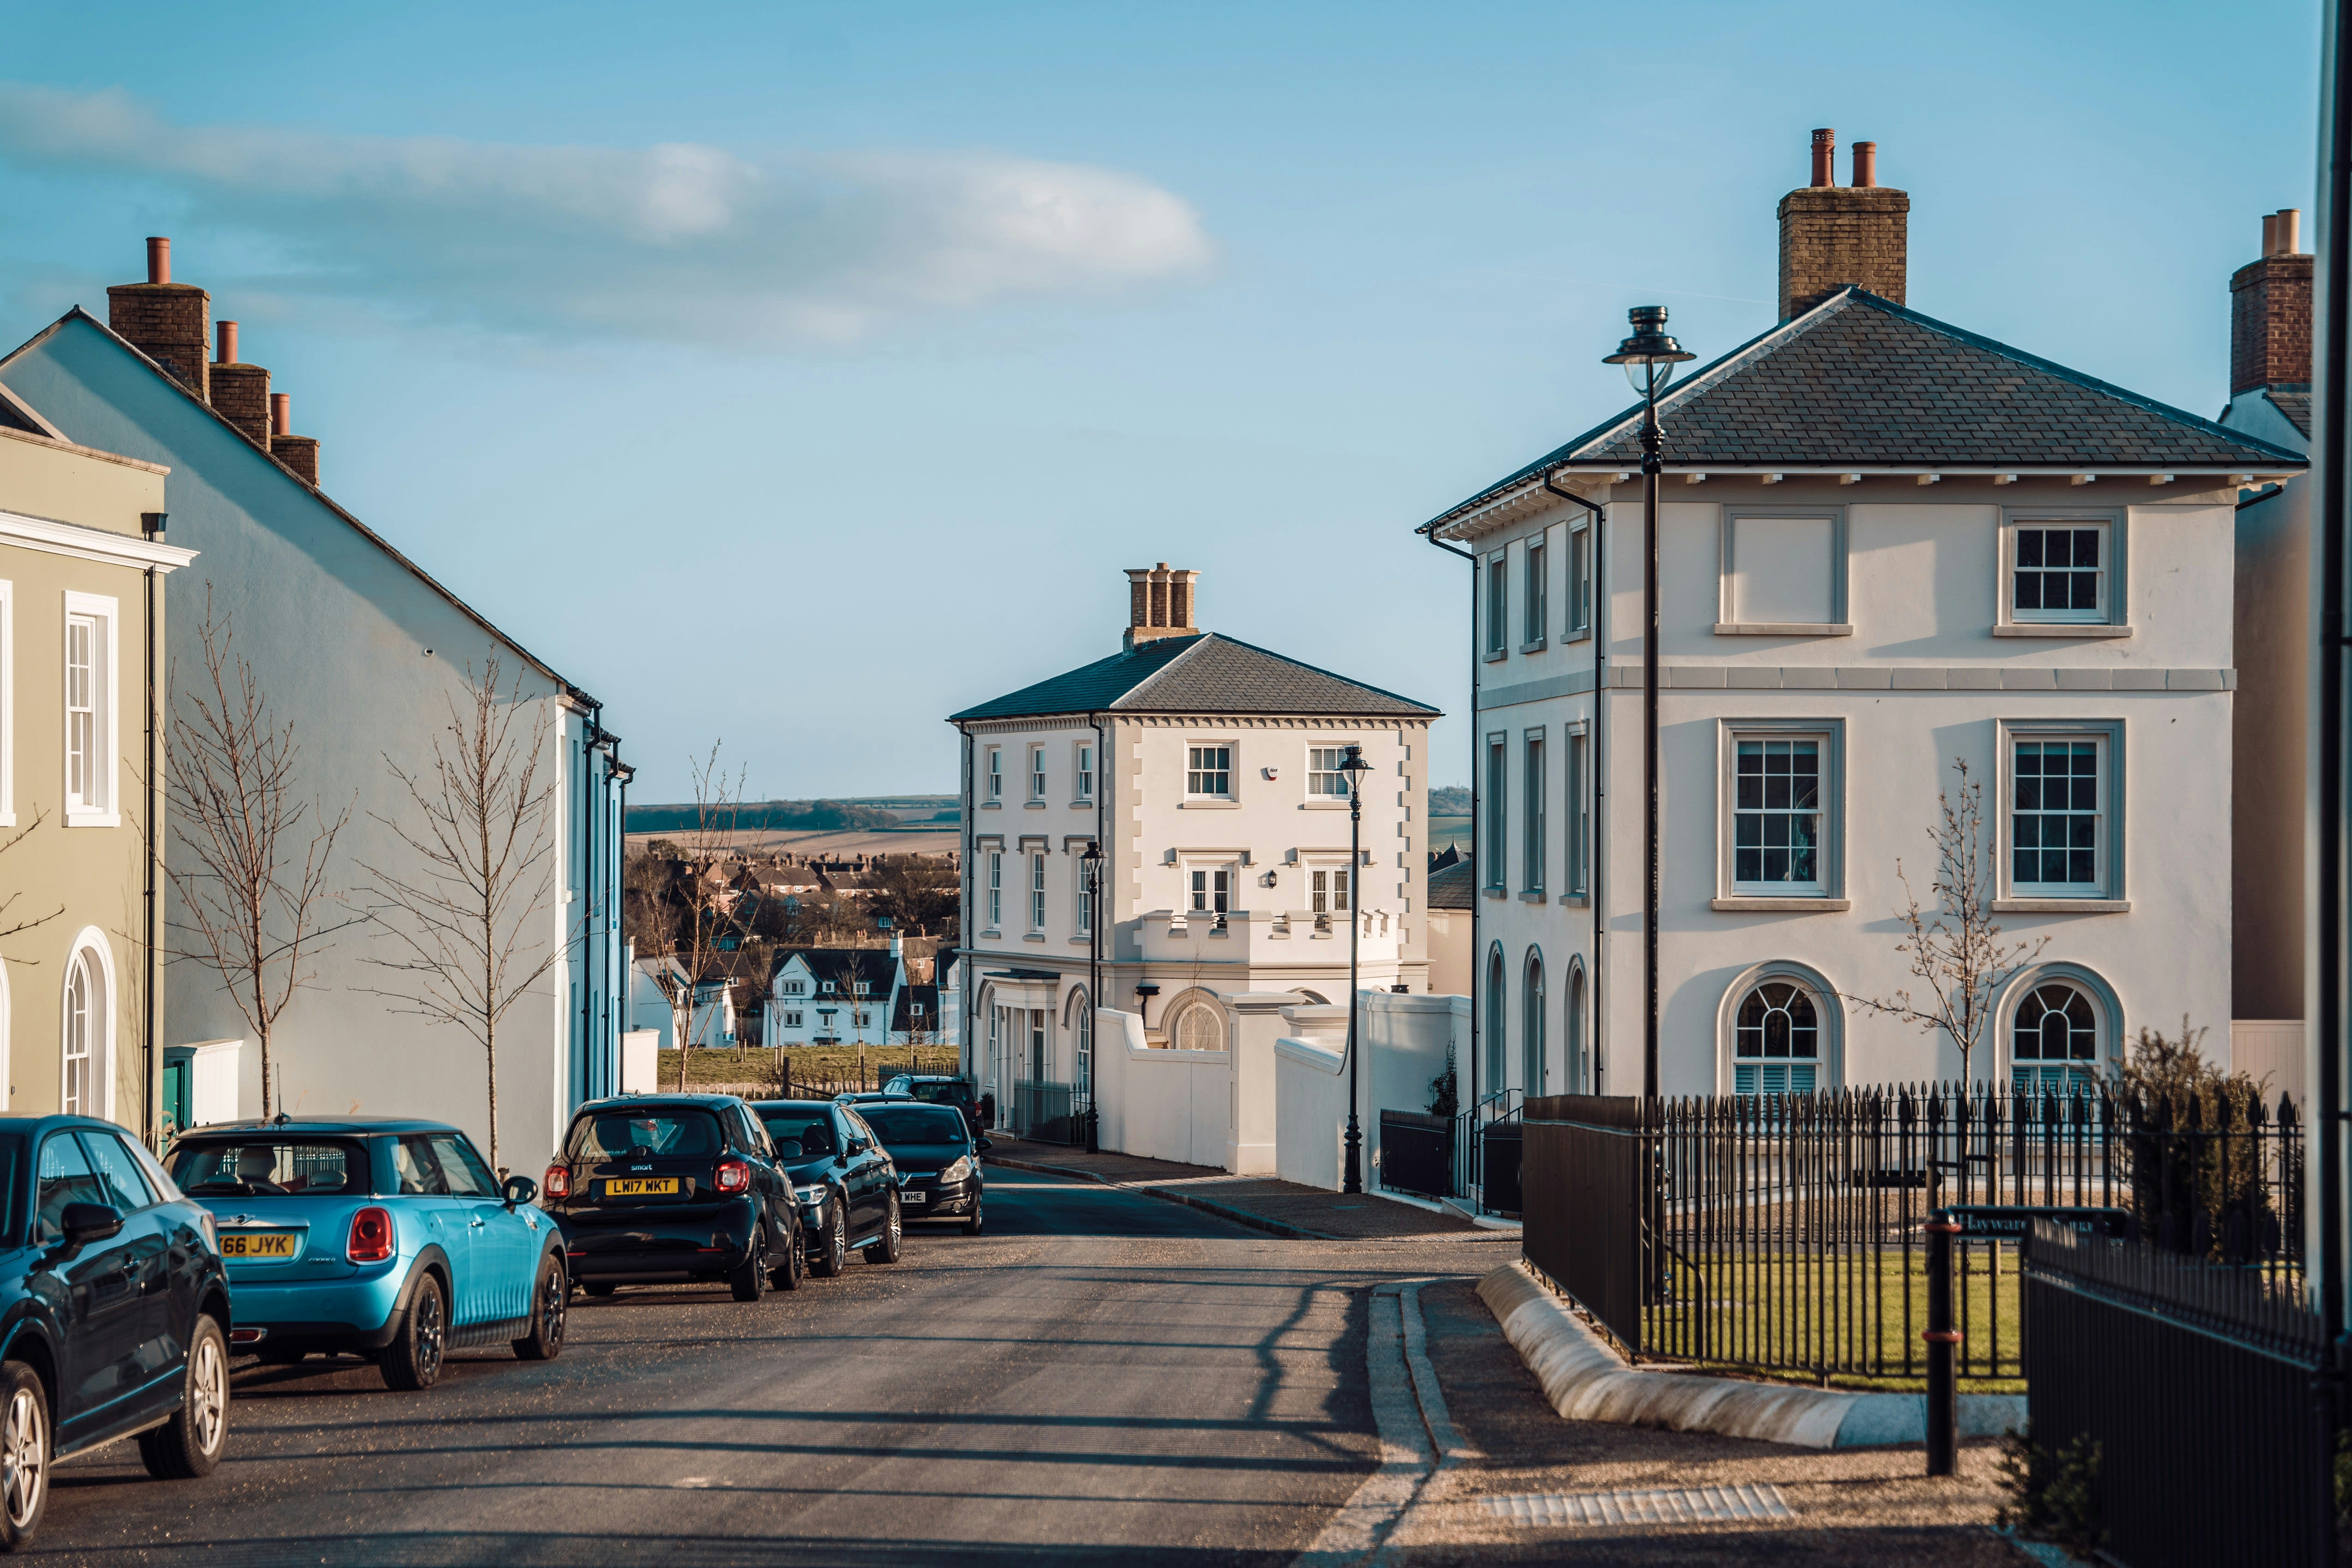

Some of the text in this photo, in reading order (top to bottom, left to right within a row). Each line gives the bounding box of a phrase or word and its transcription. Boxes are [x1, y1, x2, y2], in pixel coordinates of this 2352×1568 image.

[614, 1180, 671, 1193] LW17 WKT
[251, 1237, 287, 1253] JYK
